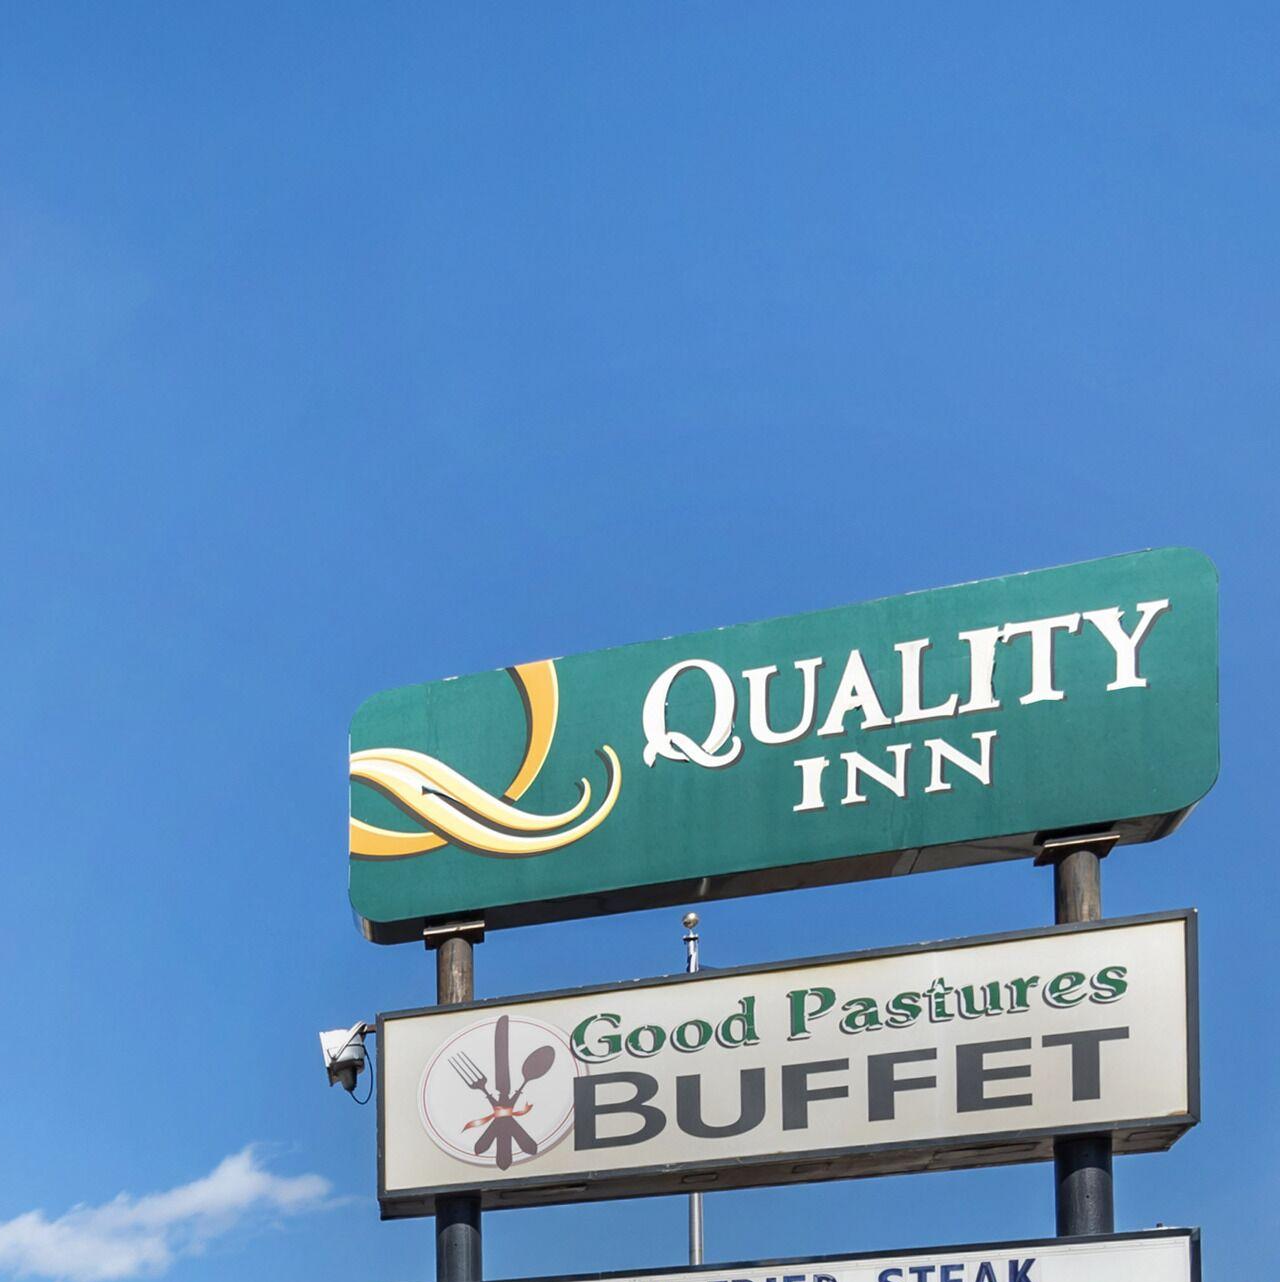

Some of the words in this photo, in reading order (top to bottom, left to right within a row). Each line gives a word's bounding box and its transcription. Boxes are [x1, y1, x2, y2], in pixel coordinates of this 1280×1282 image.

[641, 598, 1170, 768] QUALITY
[792, 729, 998, 813] INN
[569, 995, 760, 1063] Good
[786, 965, 1129, 1041] Pastures
[572, 1026, 1130, 1151] BUFFET
